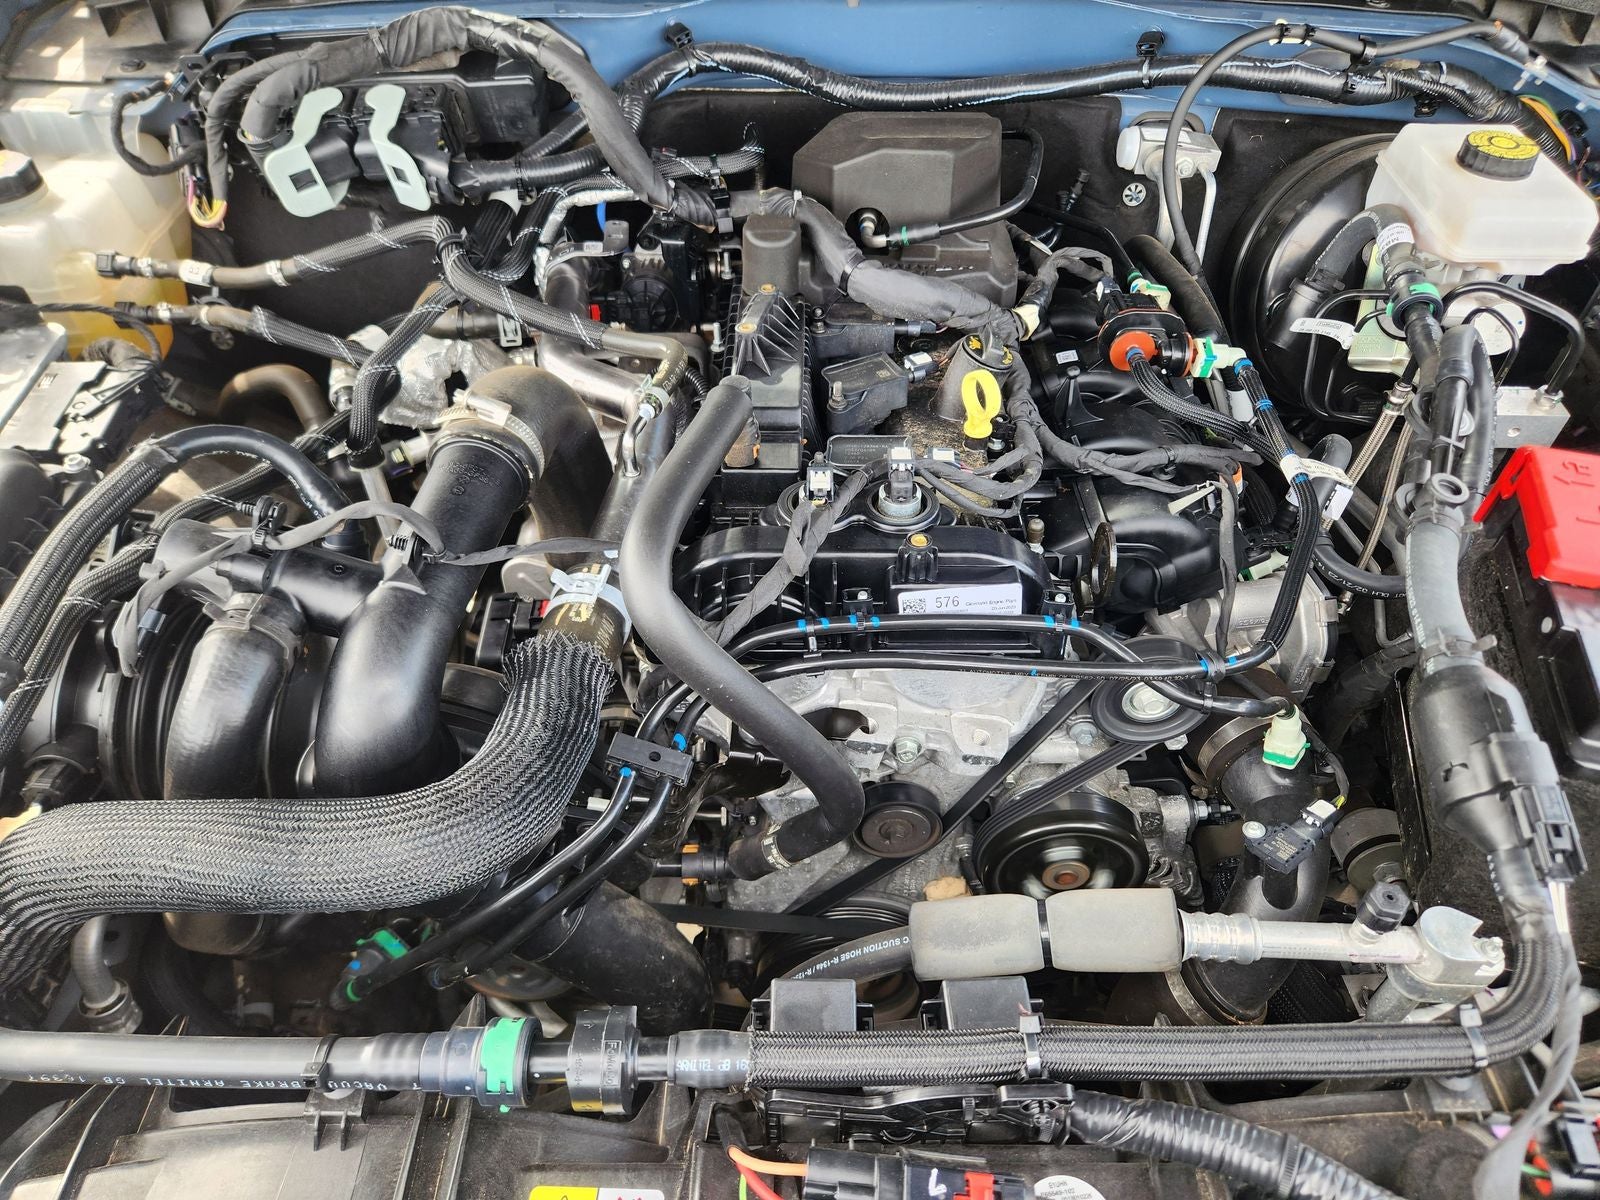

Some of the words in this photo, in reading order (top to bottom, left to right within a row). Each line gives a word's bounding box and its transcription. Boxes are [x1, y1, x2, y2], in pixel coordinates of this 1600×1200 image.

[935, 596, 960, 609] 576
[863, 938, 901, 953] SUCTION
[840, 948, 862, 961] HOSE
[816, 956, 839, 971] R-134a
[139, 1077, 225, 1088] ARNITEL
[240, 1079, 302, 1089] BRAKE
